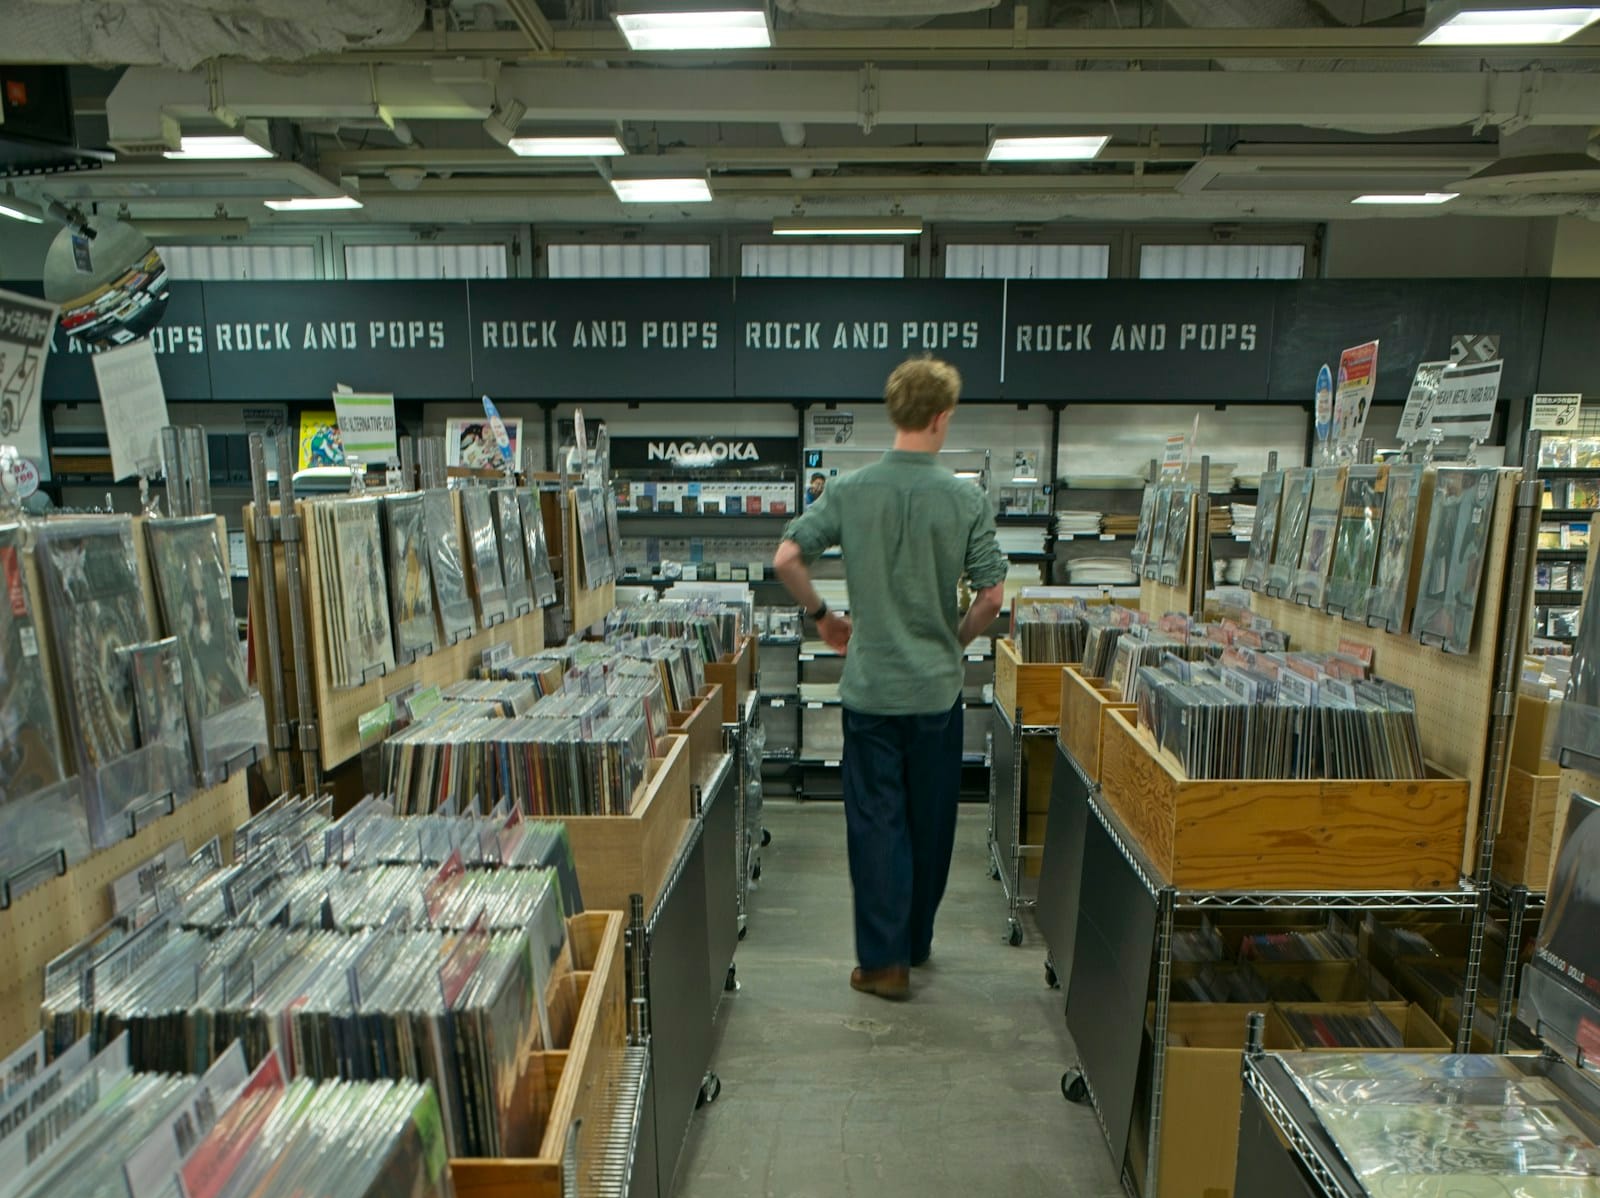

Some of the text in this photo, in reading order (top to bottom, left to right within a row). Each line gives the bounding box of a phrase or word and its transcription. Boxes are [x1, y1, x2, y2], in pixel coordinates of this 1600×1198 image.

[150, 326, 204, 353] OPS
[216, 321, 445, 351] ROCK AND POPS
[482, 321, 718, 349] ROCK AND POPS
[746, 321, 979, 349] ROCK AND POPS
[1017, 323, 1257, 351] ROCK AND POPS
[648, 442, 759, 461] NAGAOKA
[1568, 965, 1585, 983] DOLLS
